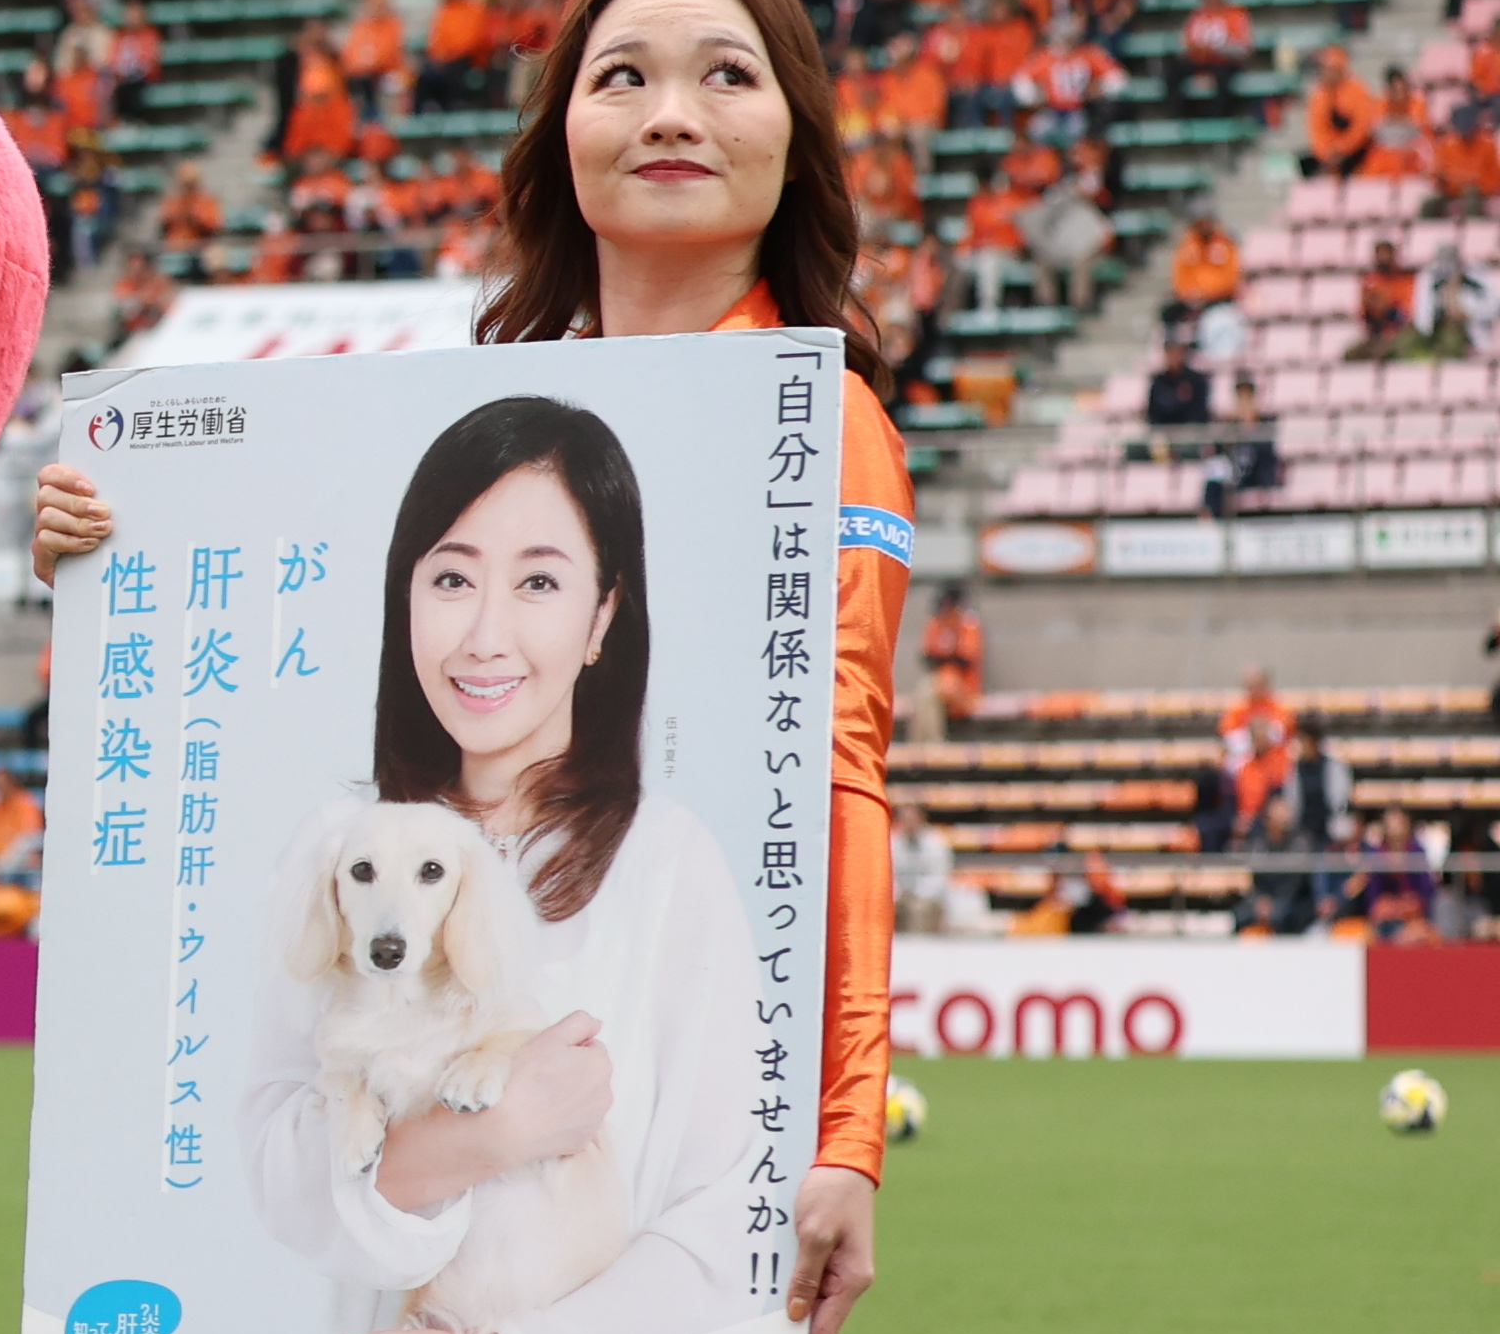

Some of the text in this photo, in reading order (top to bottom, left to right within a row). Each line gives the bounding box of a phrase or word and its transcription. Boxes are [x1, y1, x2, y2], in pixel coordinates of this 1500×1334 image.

[130, 405, 247, 440] 厚生労働省
[130, 442, 154, 450] Ministry
[220, 436, 244, 444] Welfare
[275, 542, 328, 678] がん
[93, 550, 157, 866] 性感染症
[664, 716, 677, 779] 伍代夏子
[747, 351, 821, 1295] 「自分」は関係ないと思っていませんか!!
